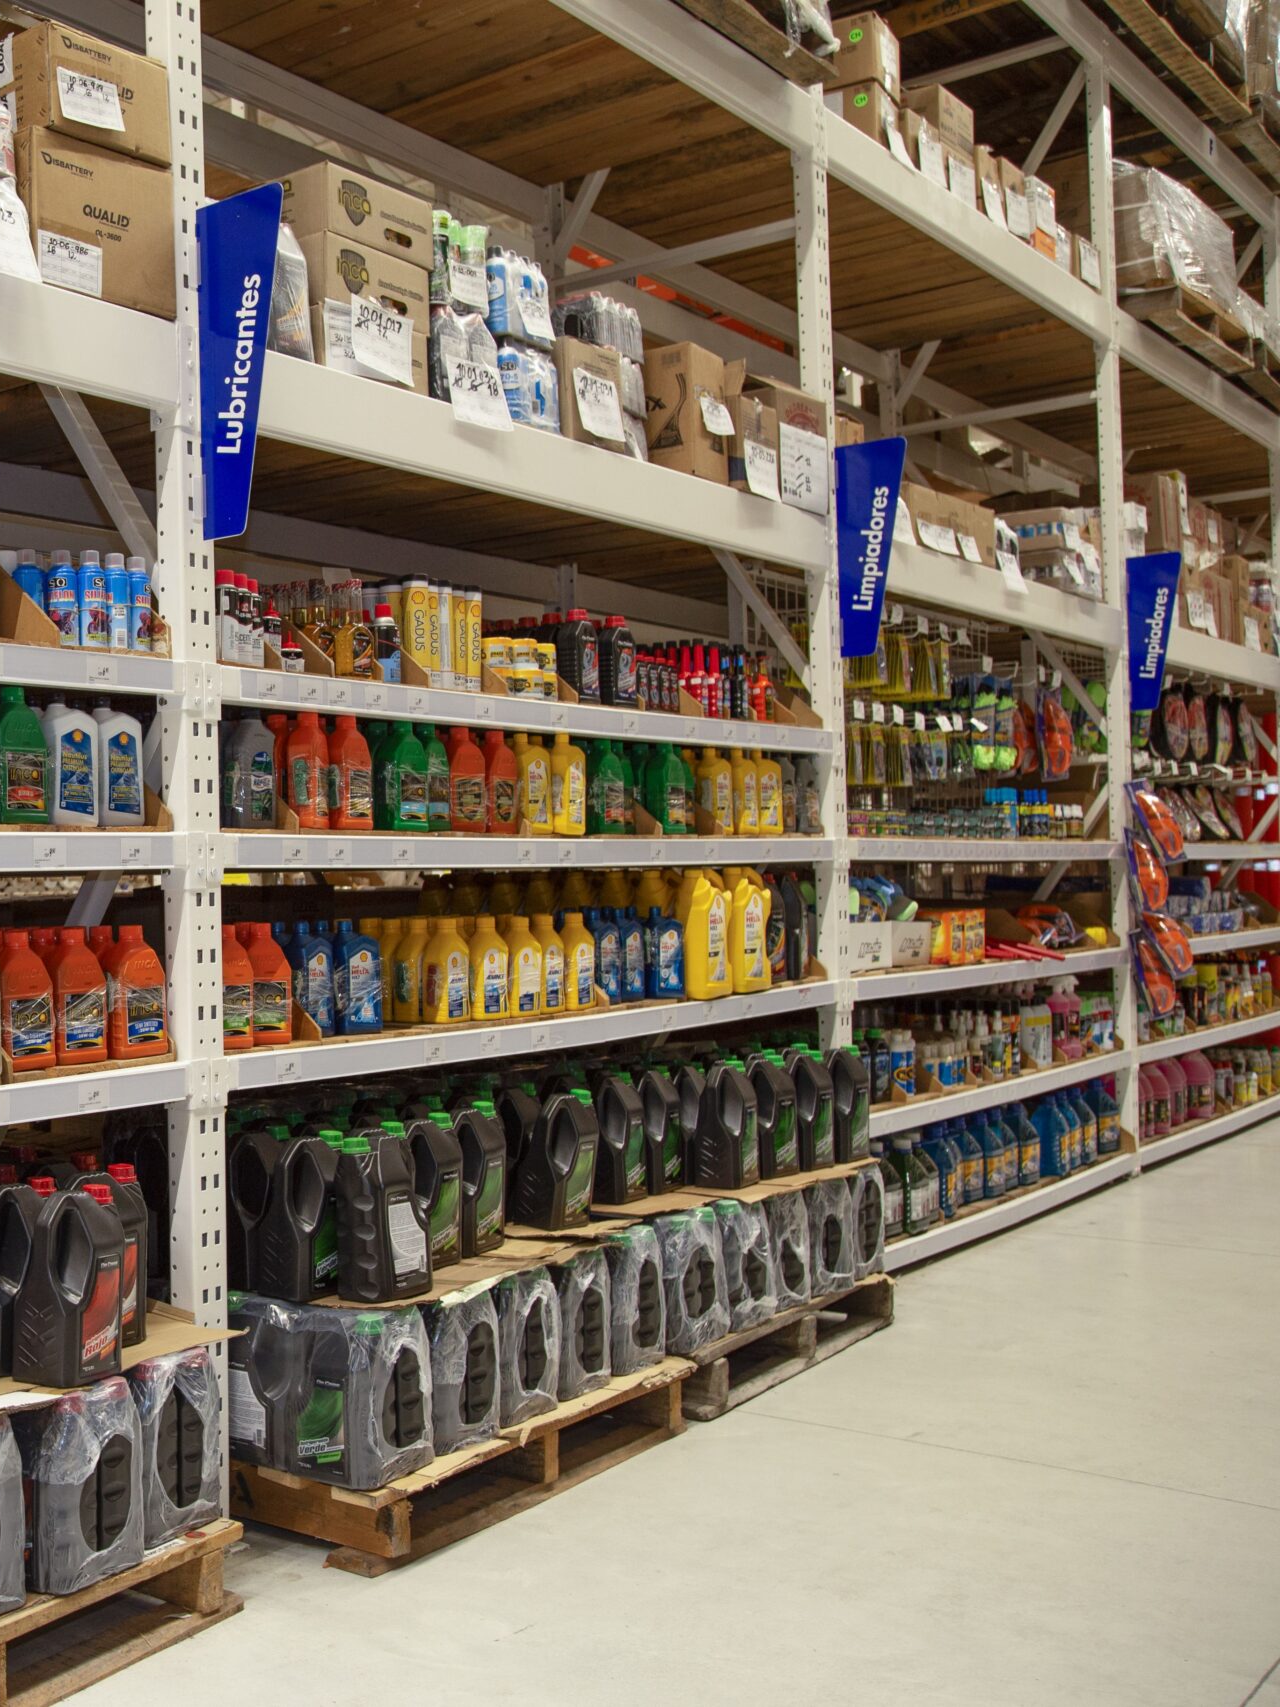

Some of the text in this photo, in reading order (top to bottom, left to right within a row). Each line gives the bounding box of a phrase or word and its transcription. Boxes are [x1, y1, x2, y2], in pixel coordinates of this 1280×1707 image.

[82, 204, 131, 229] QUALID
[338, 188, 372, 216] inca
[337, 257, 371, 285] inca
[216, 273, 262, 455] Lubricantes
[852, 486, 889, 611] Limpiadores
[414, 609, 425, 651] GADUS
[430, 614, 438, 656] GADUS
[472, 622, 480, 662] GADUS
[1140, 586, 1168, 679] Limpiadores
[10, 766, 40, 781] inca
[299, 1443, 326, 1454] Verde
